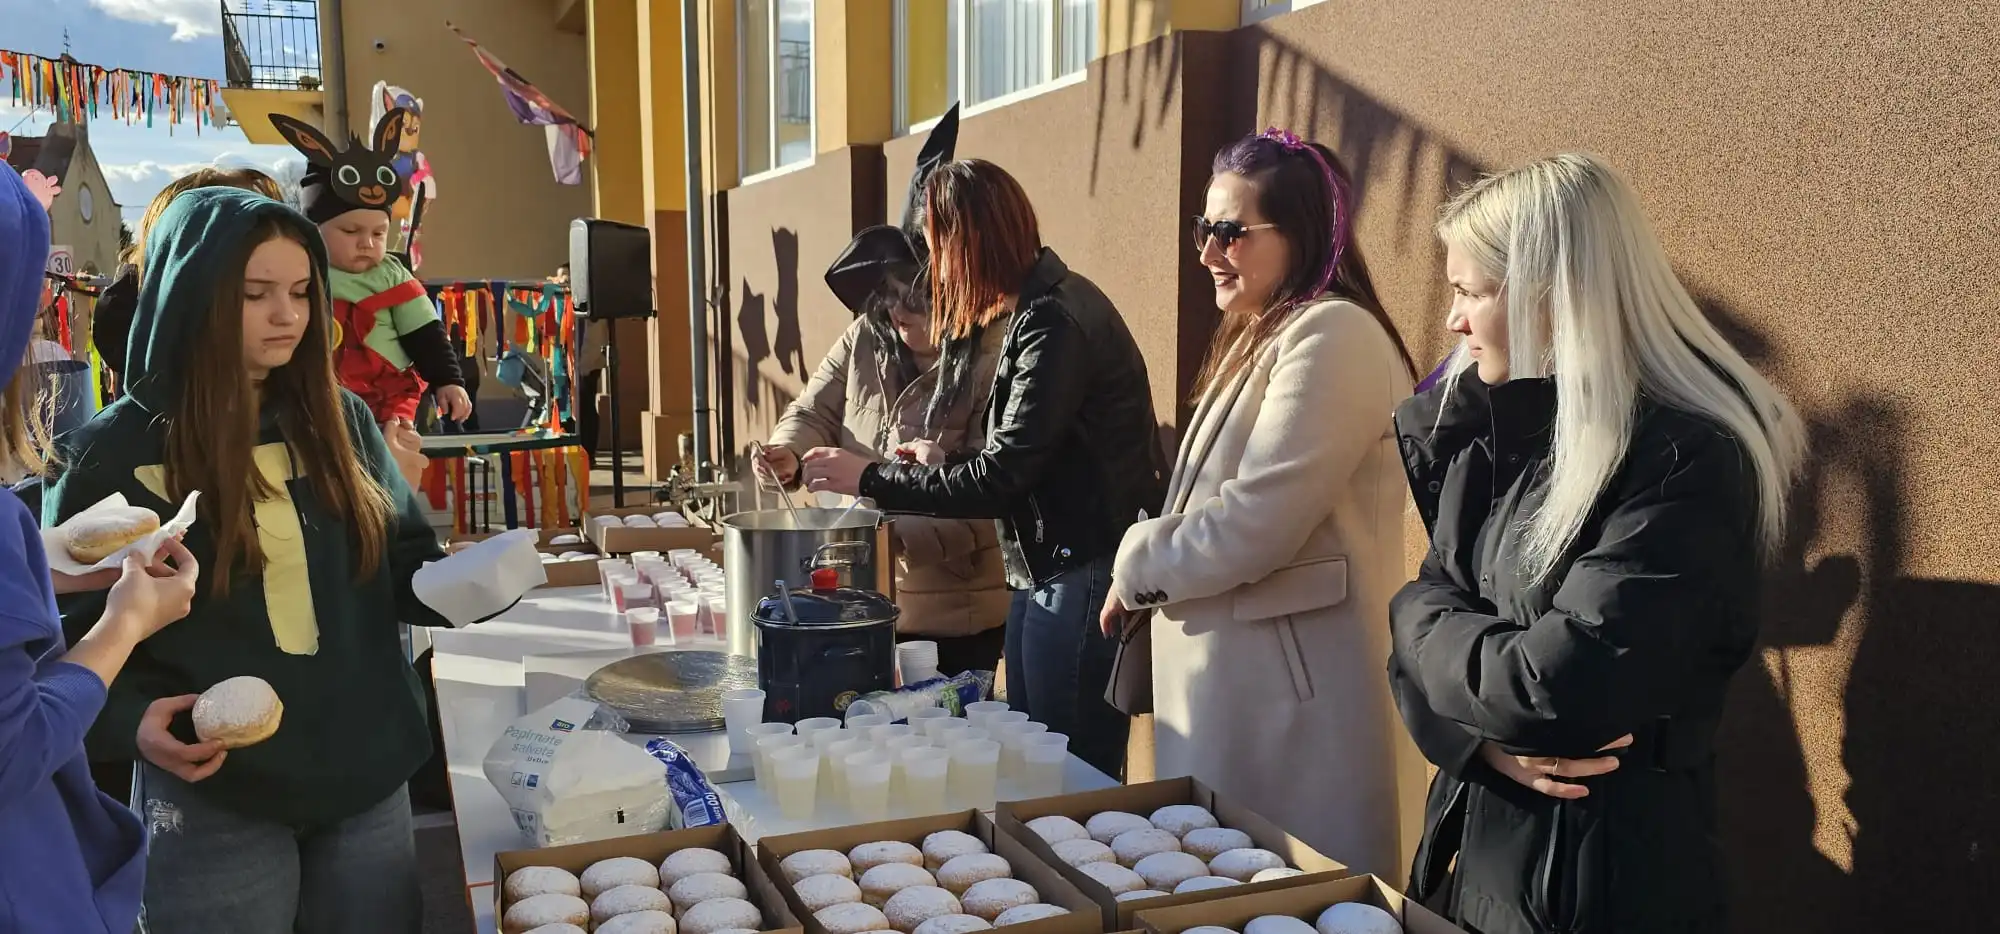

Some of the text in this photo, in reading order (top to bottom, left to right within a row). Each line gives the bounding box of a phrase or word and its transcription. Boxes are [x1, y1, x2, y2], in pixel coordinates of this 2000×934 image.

[54, 257, 72, 273] 30
[504, 725, 563, 747] Papirnate
[704, 792, 720, 806] 100
